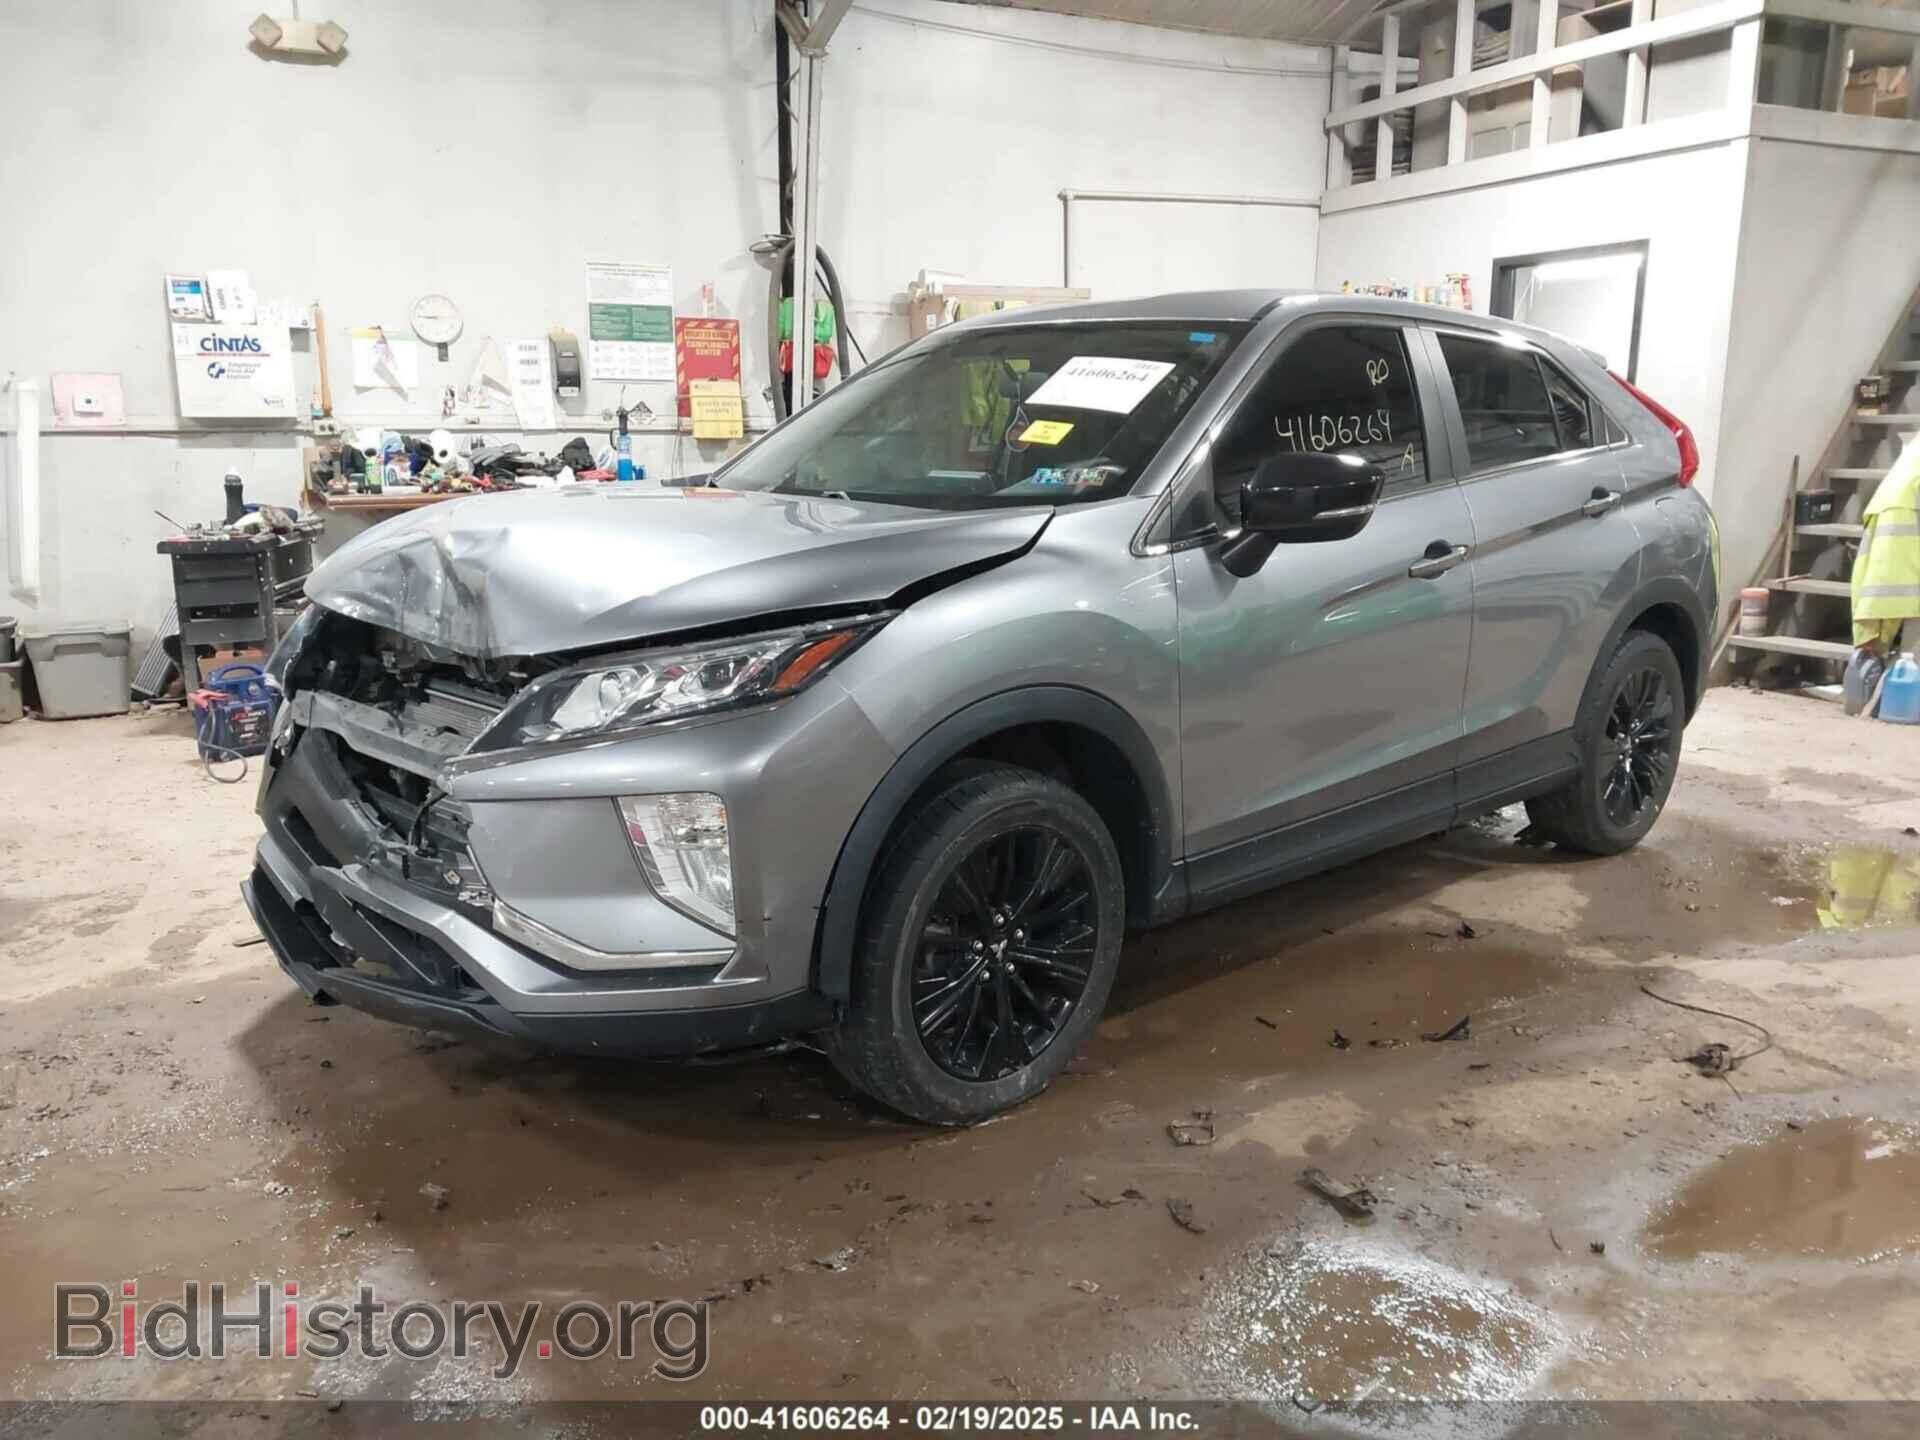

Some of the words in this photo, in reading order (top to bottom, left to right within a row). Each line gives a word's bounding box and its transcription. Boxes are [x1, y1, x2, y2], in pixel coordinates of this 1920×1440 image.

[1067, 367, 1149, 382] 41606264
[1274, 409, 1393, 453] 41606264
[1401, 443, 1416, 473] A
